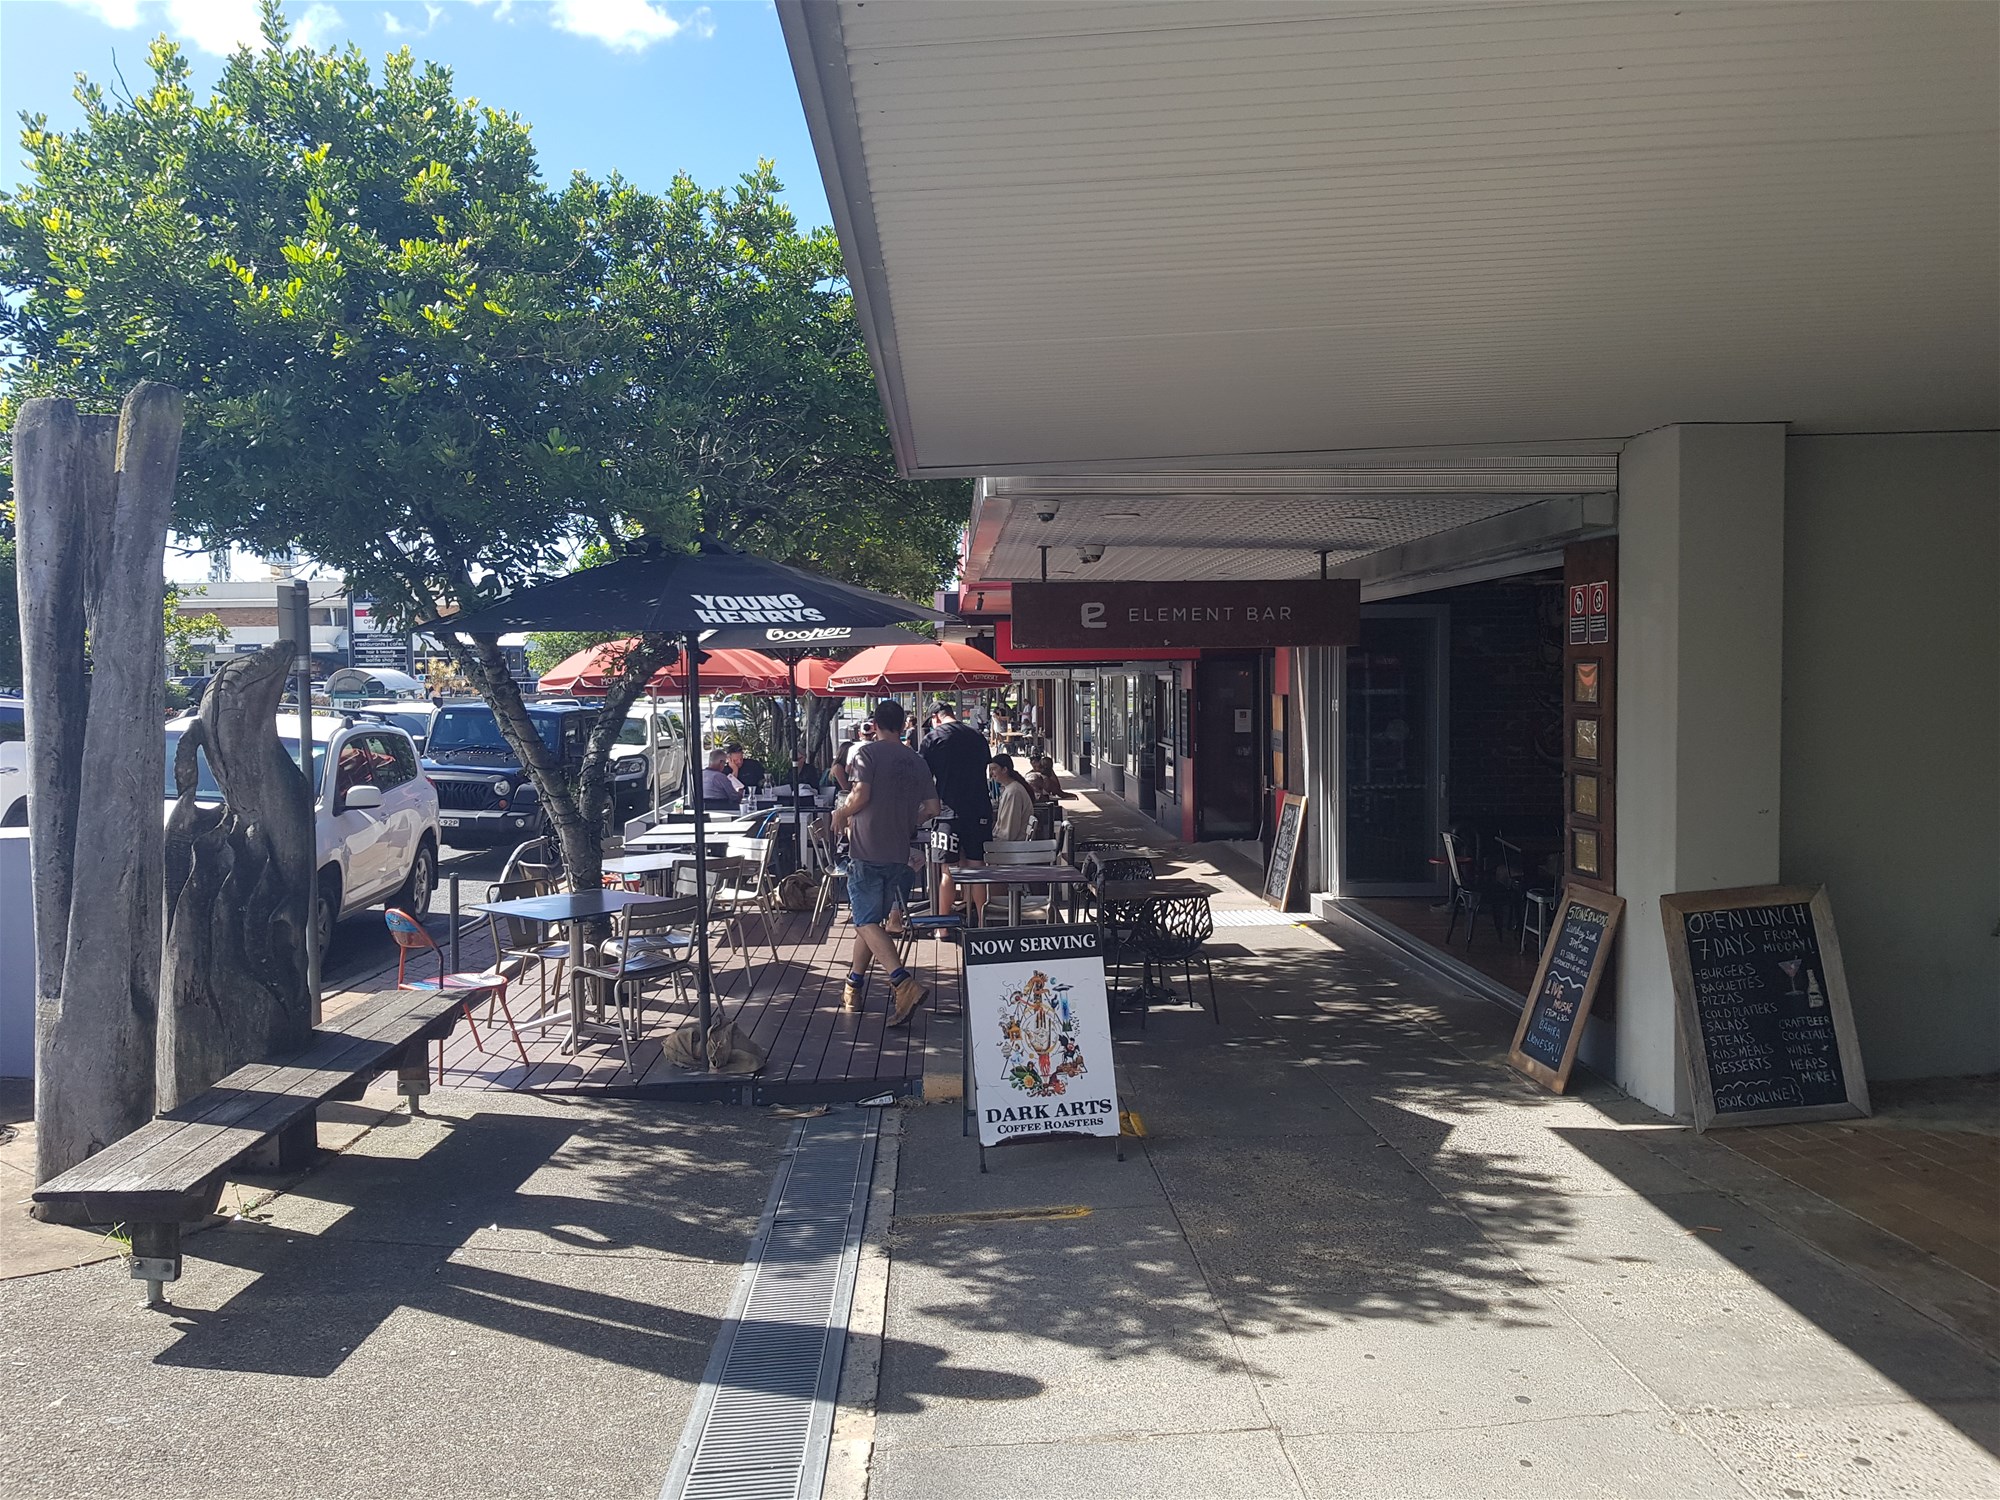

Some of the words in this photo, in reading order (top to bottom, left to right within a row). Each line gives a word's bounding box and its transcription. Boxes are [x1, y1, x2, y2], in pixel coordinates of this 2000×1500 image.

[690, 593, 805, 611] YOUNG
[694, 607, 827, 624] HENRYS
[1128, 607, 1234, 622] ELEMENT
[1247, 606, 1292, 620] BAR
[765, 627, 852, 643] Coopers
[1688, 910, 1744, 933] OPEN
[1746, 904, 1806, 927] LUNCH
[1763, 928, 1799, 941] FROM
[970, 939, 1015, 956] NOW
[1020, 933, 1097, 953] SERVING
[1692, 939, 1711, 960] 7
[1714, 932, 1756, 958] DAYS
[1545, 979, 1565, 999] LIVE
[1806, 1015, 1830, 1027] BEER
[1781, 1028, 1834, 1041] COCKTAILS
[1739, 1043, 1774, 1058] MEALS
[1785, 1043, 1814, 1056] WINE
[1790, 1057, 1828, 1071] HEAPS
[1717, 1093, 1747, 1110] BOOK
[985, 1104, 1050, 1124] DARK
[1054, 1098, 1112, 1118] ARTS
[997, 1122, 1041, 1135] COFFEE
[1044, 1117, 1104, 1131] ROASTERS
